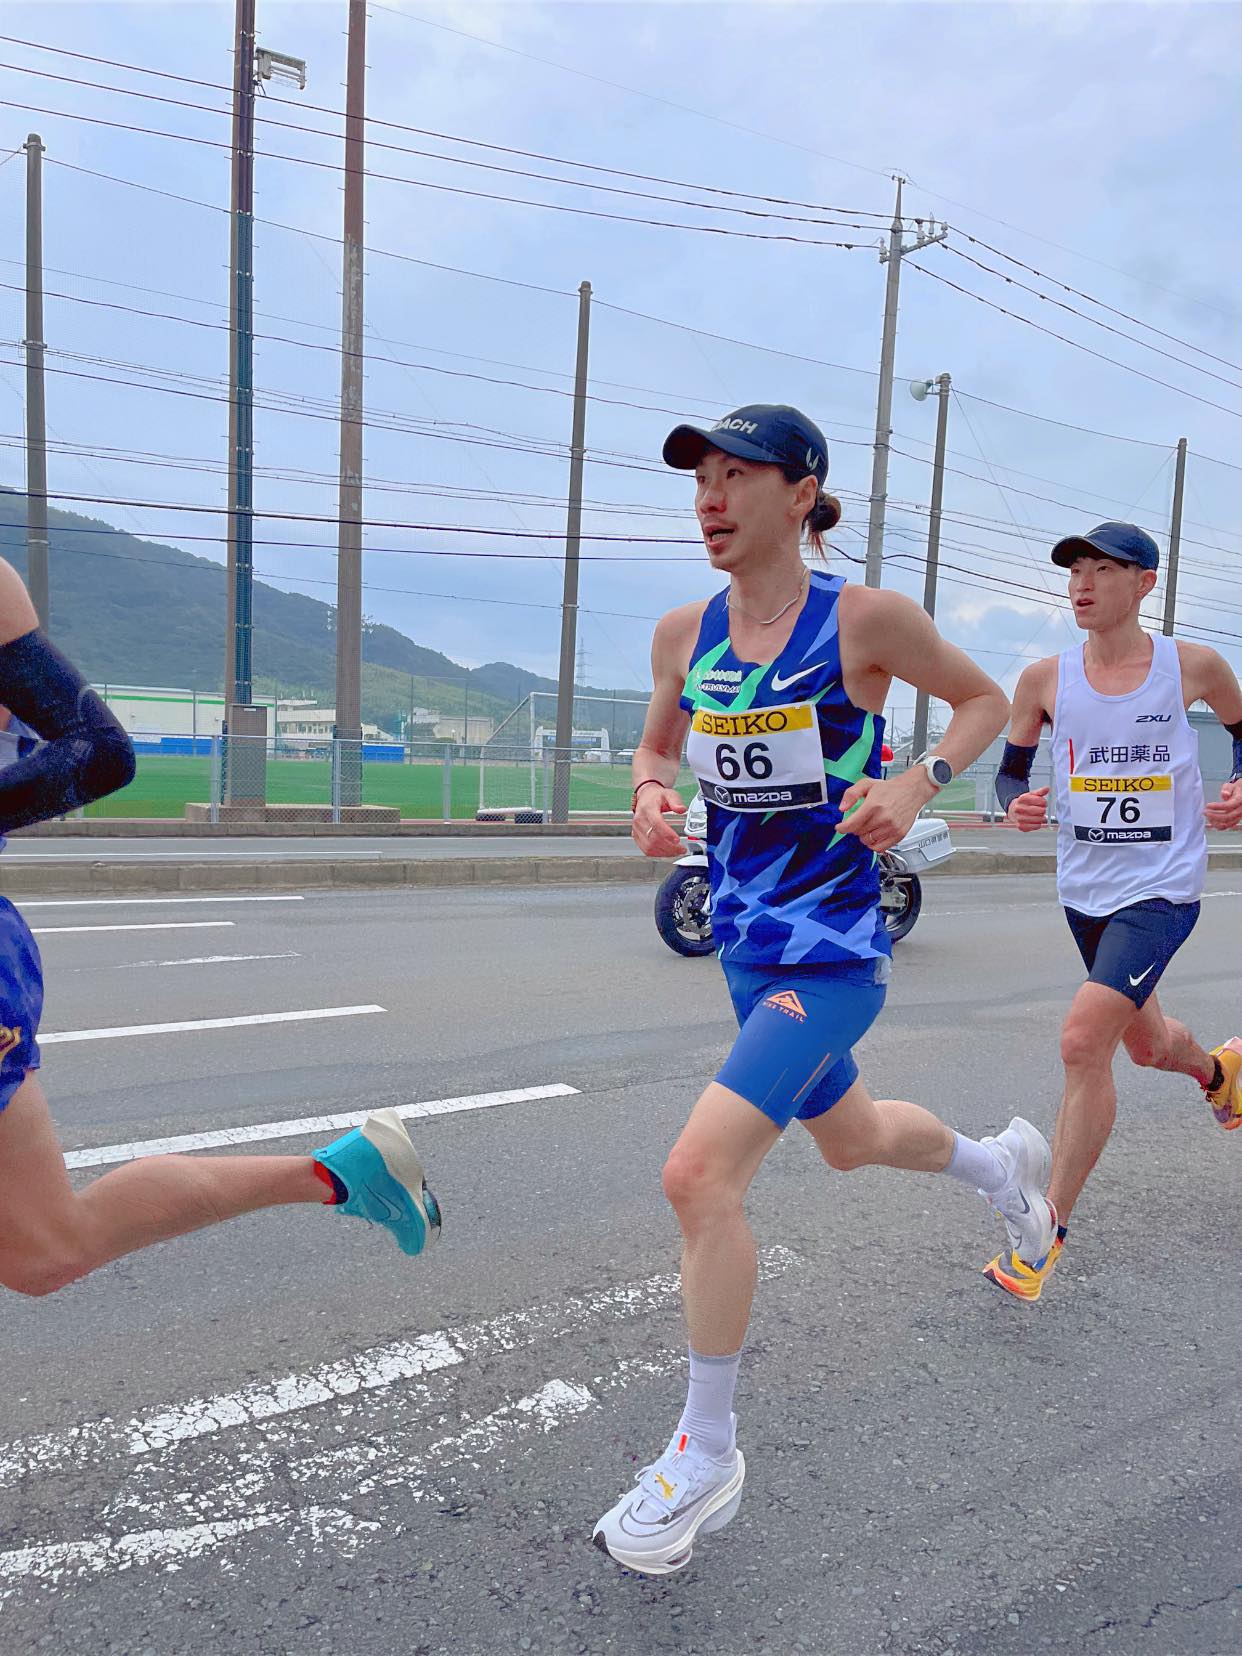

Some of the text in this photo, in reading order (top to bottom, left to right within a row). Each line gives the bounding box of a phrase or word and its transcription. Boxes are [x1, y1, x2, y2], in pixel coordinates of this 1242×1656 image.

[701, 710, 788, 736] SEIKO
[715, 742, 773, 781] 66
[1088, 744, 1170, 764] 武田薬品
[1084, 777, 1154, 792] SEIKO
[1096, 796, 1141, 824] 76
